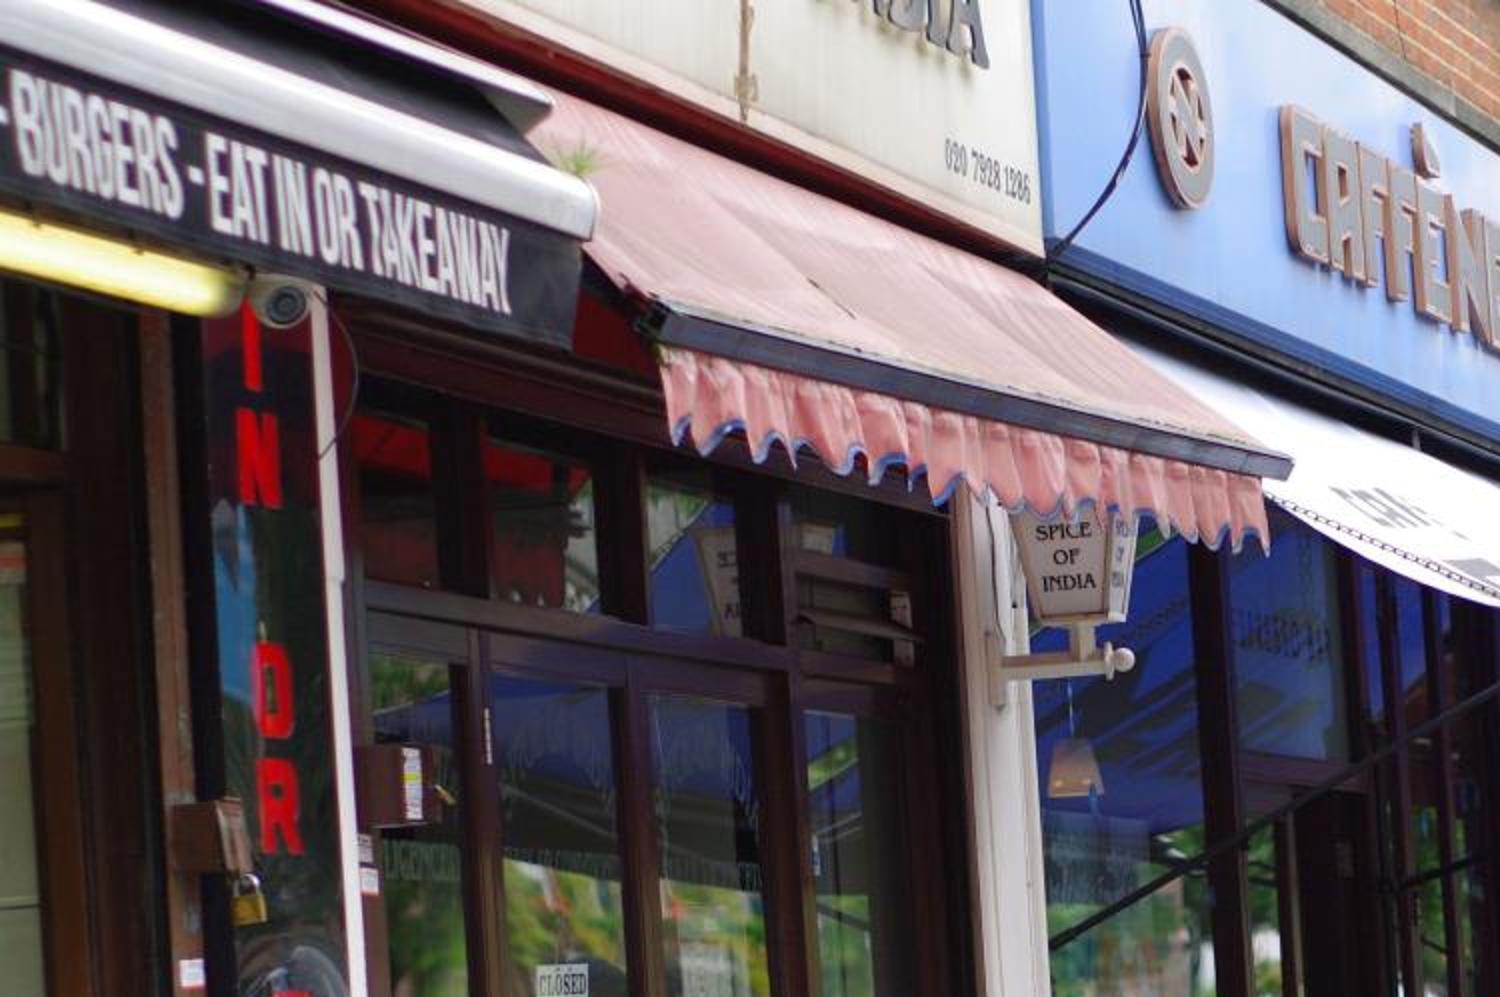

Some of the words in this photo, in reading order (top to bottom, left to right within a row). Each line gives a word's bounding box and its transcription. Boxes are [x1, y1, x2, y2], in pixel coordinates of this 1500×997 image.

[945, 137, 969, 178] 020
[9, 67, 184, 220] BURGERS
[205, 131, 270, 246] EAT
[272, 154, 314, 257] IN
[313, 167, 364, 271] OR
[357, 180, 512, 316] TAKEAWAY
[1035, 521, 1092, 542] SPICE
[1052, 548, 1081, 565] OF
[1041, 573, 1097, 592] INDIA
[539, 973, 587, 997] CLOSED
